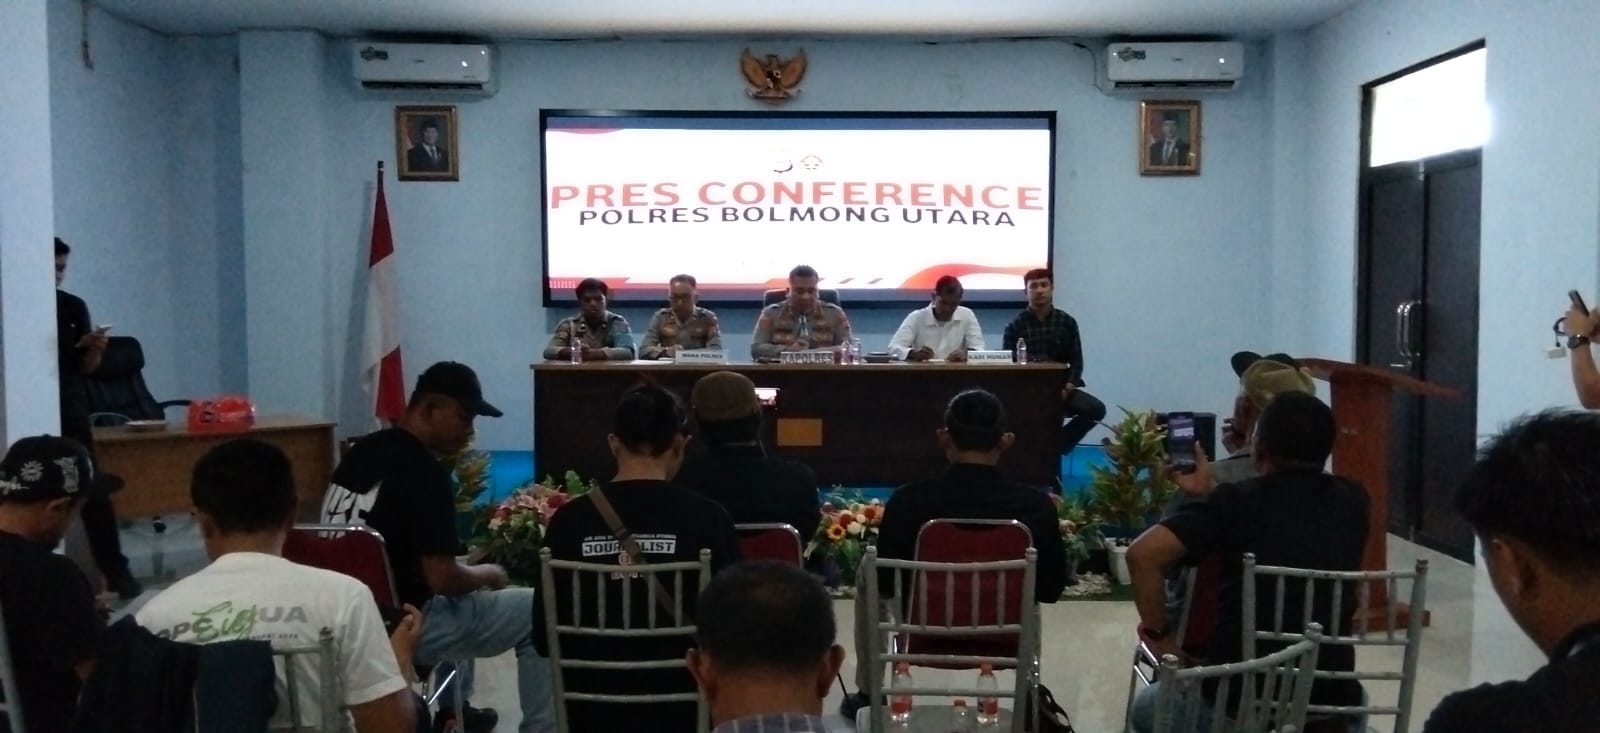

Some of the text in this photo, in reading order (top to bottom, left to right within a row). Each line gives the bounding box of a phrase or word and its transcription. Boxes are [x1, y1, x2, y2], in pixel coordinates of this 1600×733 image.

[551, 181, 1044, 211] PRES CONFERENCE
[579, 206, 1016, 227] POLRES BOLMONG UTARA
